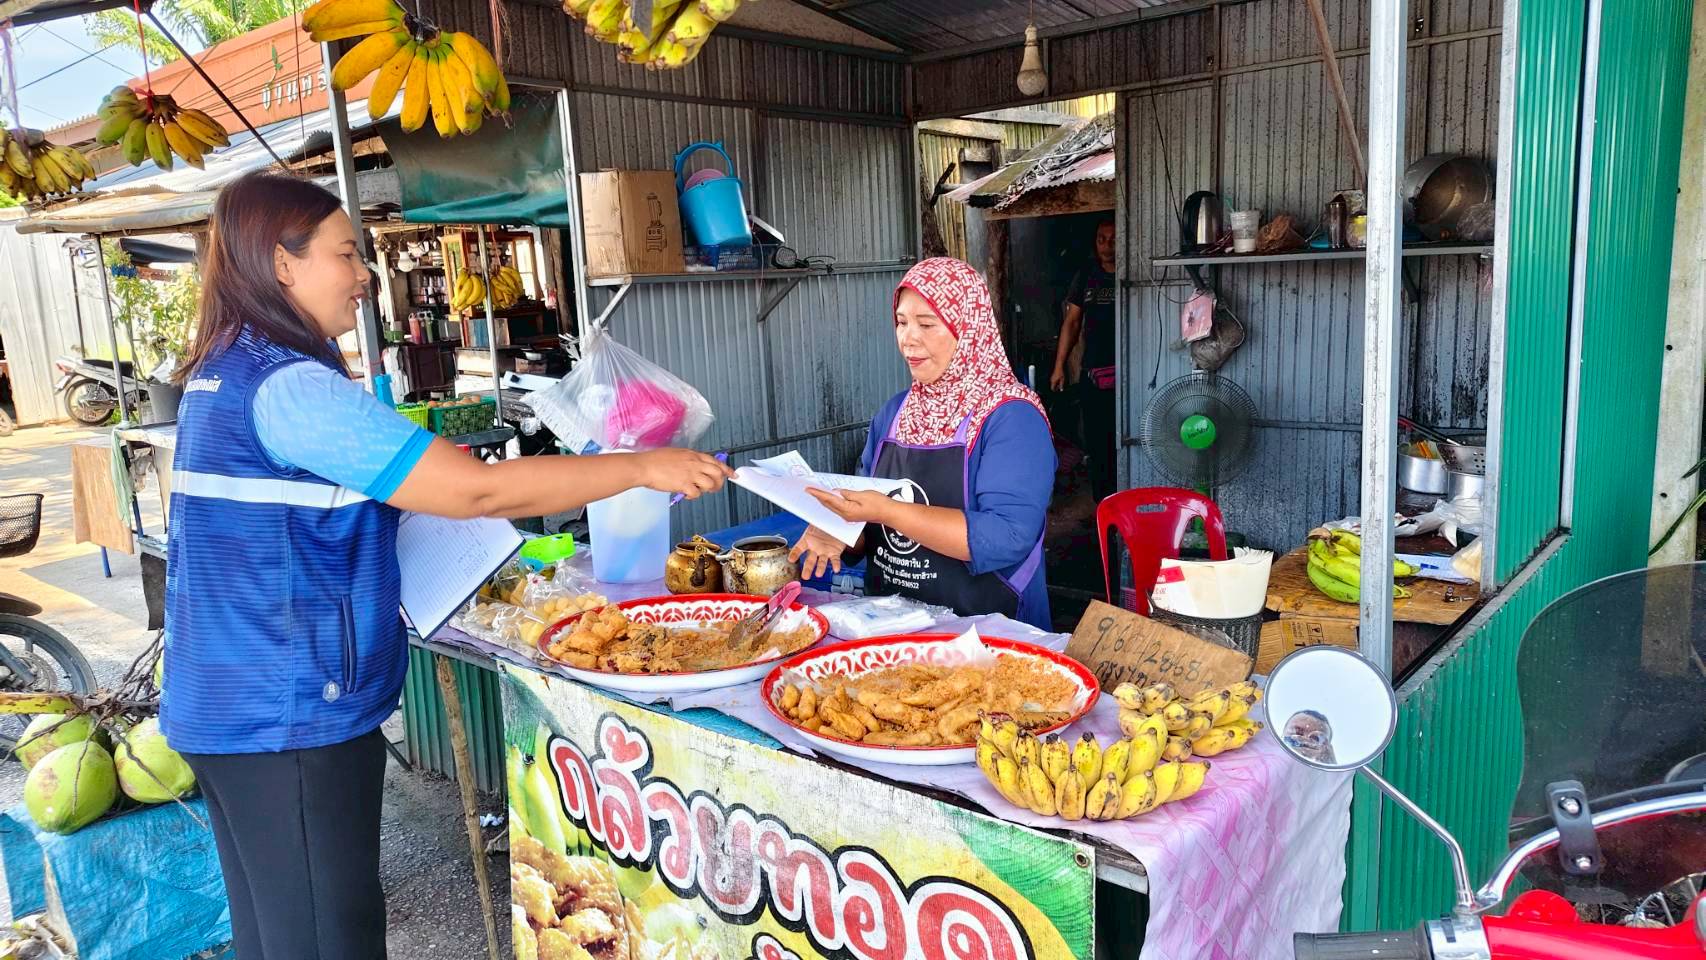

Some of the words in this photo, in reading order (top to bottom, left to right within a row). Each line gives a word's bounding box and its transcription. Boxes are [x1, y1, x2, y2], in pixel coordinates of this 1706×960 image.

[923, 559, 930, 568] 2
[548, 713, 1034, 960] กล้วยทอด
